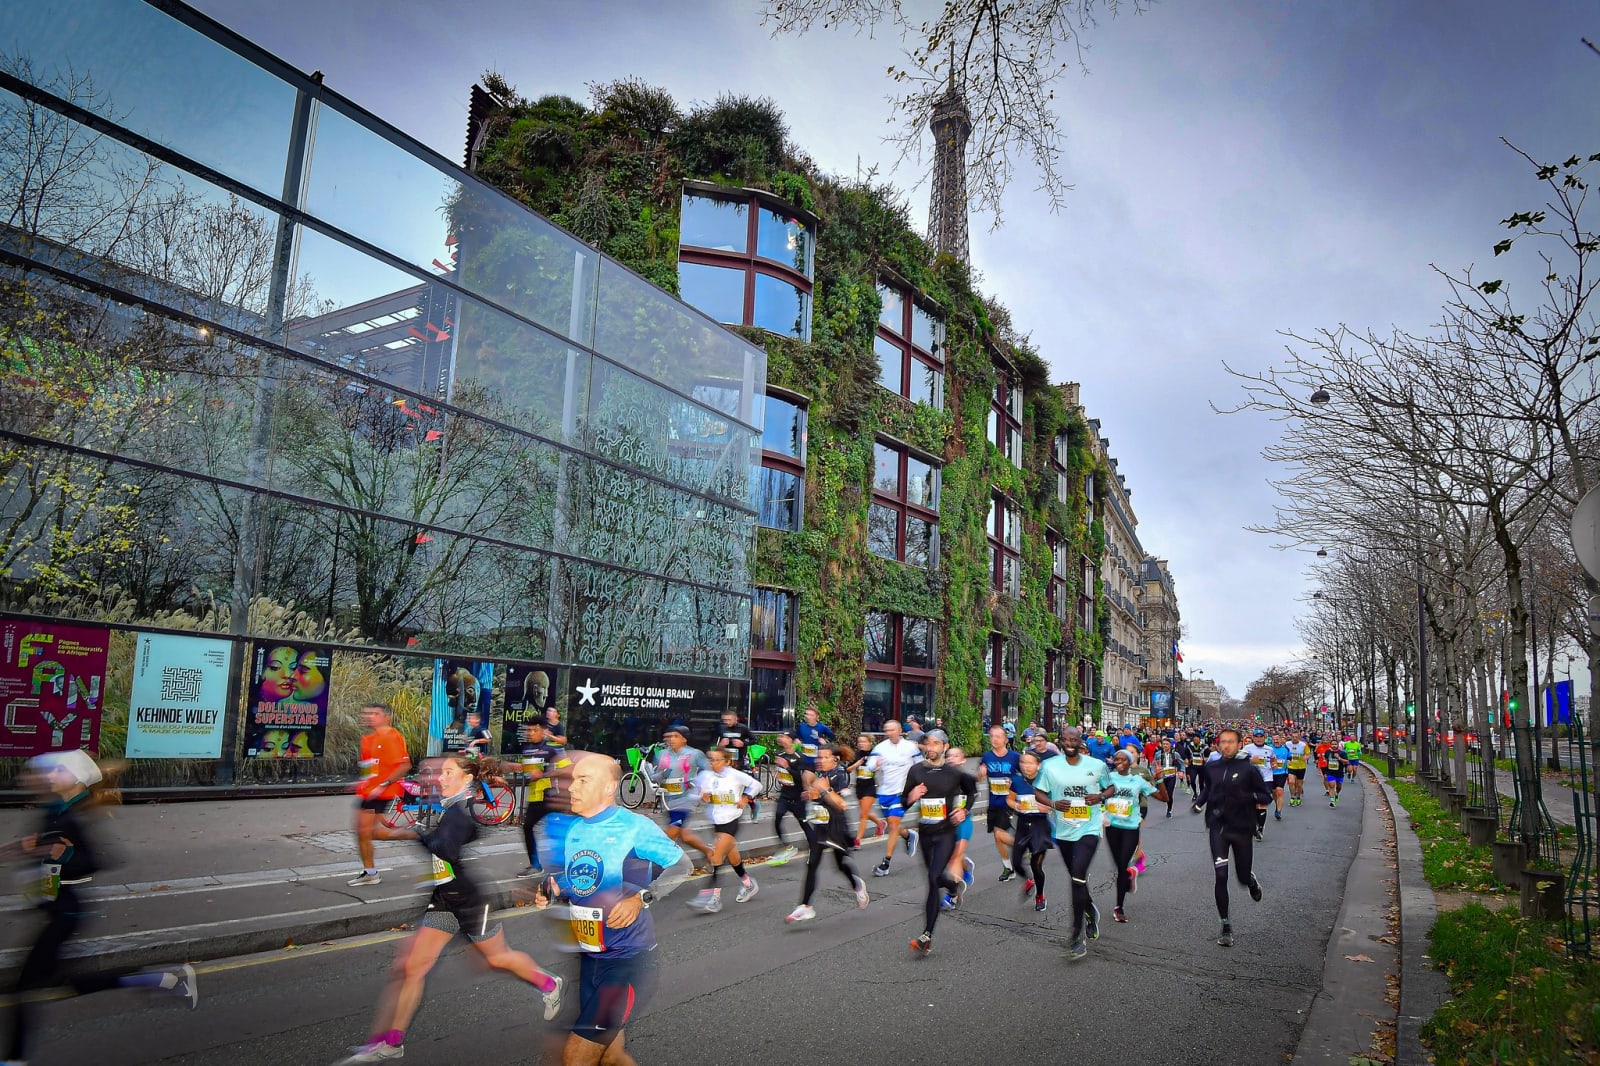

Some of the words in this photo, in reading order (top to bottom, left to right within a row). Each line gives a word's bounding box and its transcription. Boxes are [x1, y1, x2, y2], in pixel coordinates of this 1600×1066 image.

[602, 683, 631, 696] MUSÉE
[633, 686, 645, 697] DU
[646, 687, 665, 698] QUAI
[666, 688, 695, 699] BRANLY
[258, 701, 318, 714] BOLLYWOOD
[601, 696, 639, 708] JACQUES
[641, 698, 670, 709] CHIRAC
[137, 707, 183, 723] KEHINDE
[185, 709, 218, 724] WILEY
[255, 713, 319, 725] SUPERSTARS
[572, 850, 602, 863] TRIATHLON
